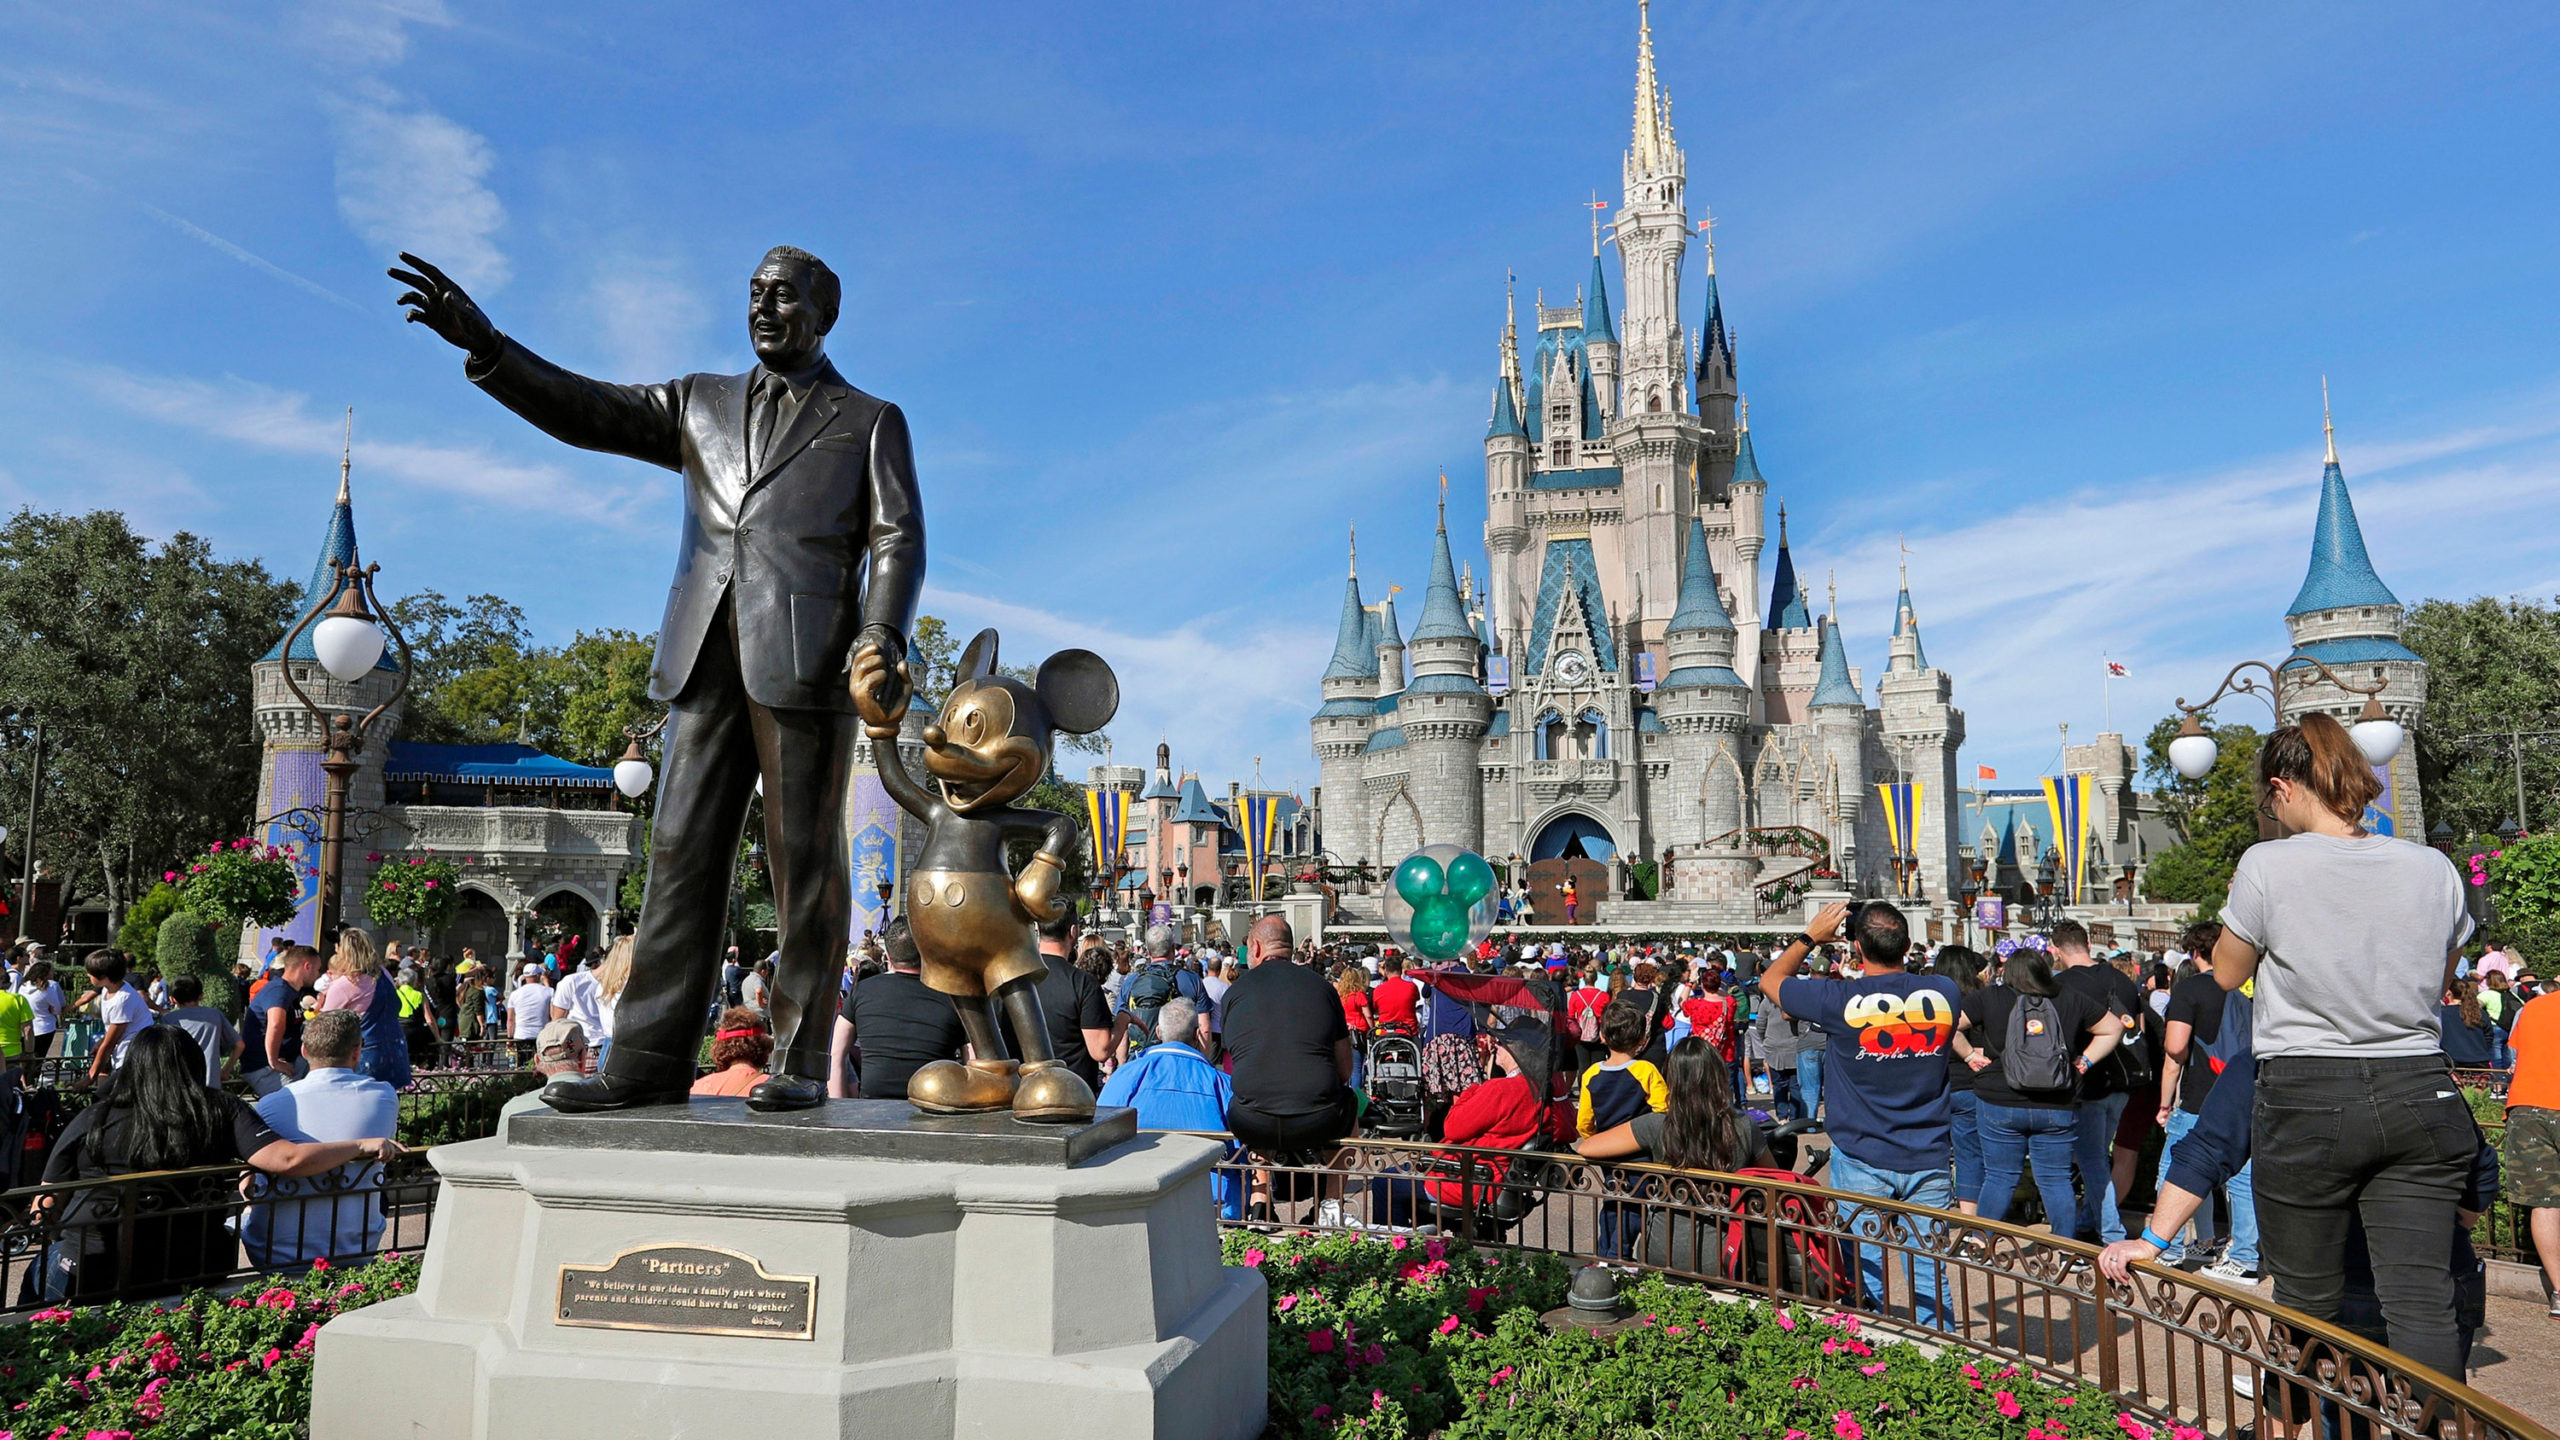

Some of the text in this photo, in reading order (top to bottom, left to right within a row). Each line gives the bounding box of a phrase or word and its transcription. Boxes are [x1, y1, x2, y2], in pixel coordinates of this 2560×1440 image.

[603, 1280, 635, 1290] believe
[638, 1283, 647, 1292] in
[650, 1285, 665, 1293] our
[701, 1287, 730, 1299] family
[733, 1289, 755, 1299] park
[758, 1291, 787, 1299] where
[574, 1293, 608, 1303] parents
[611, 1295, 627, 1303] and
[630, 1295, 668, 1305] children
[671, 1298, 696, 1307] could
[699, 1299, 720, 1309] have
[723, 1300, 739, 1310] fun
